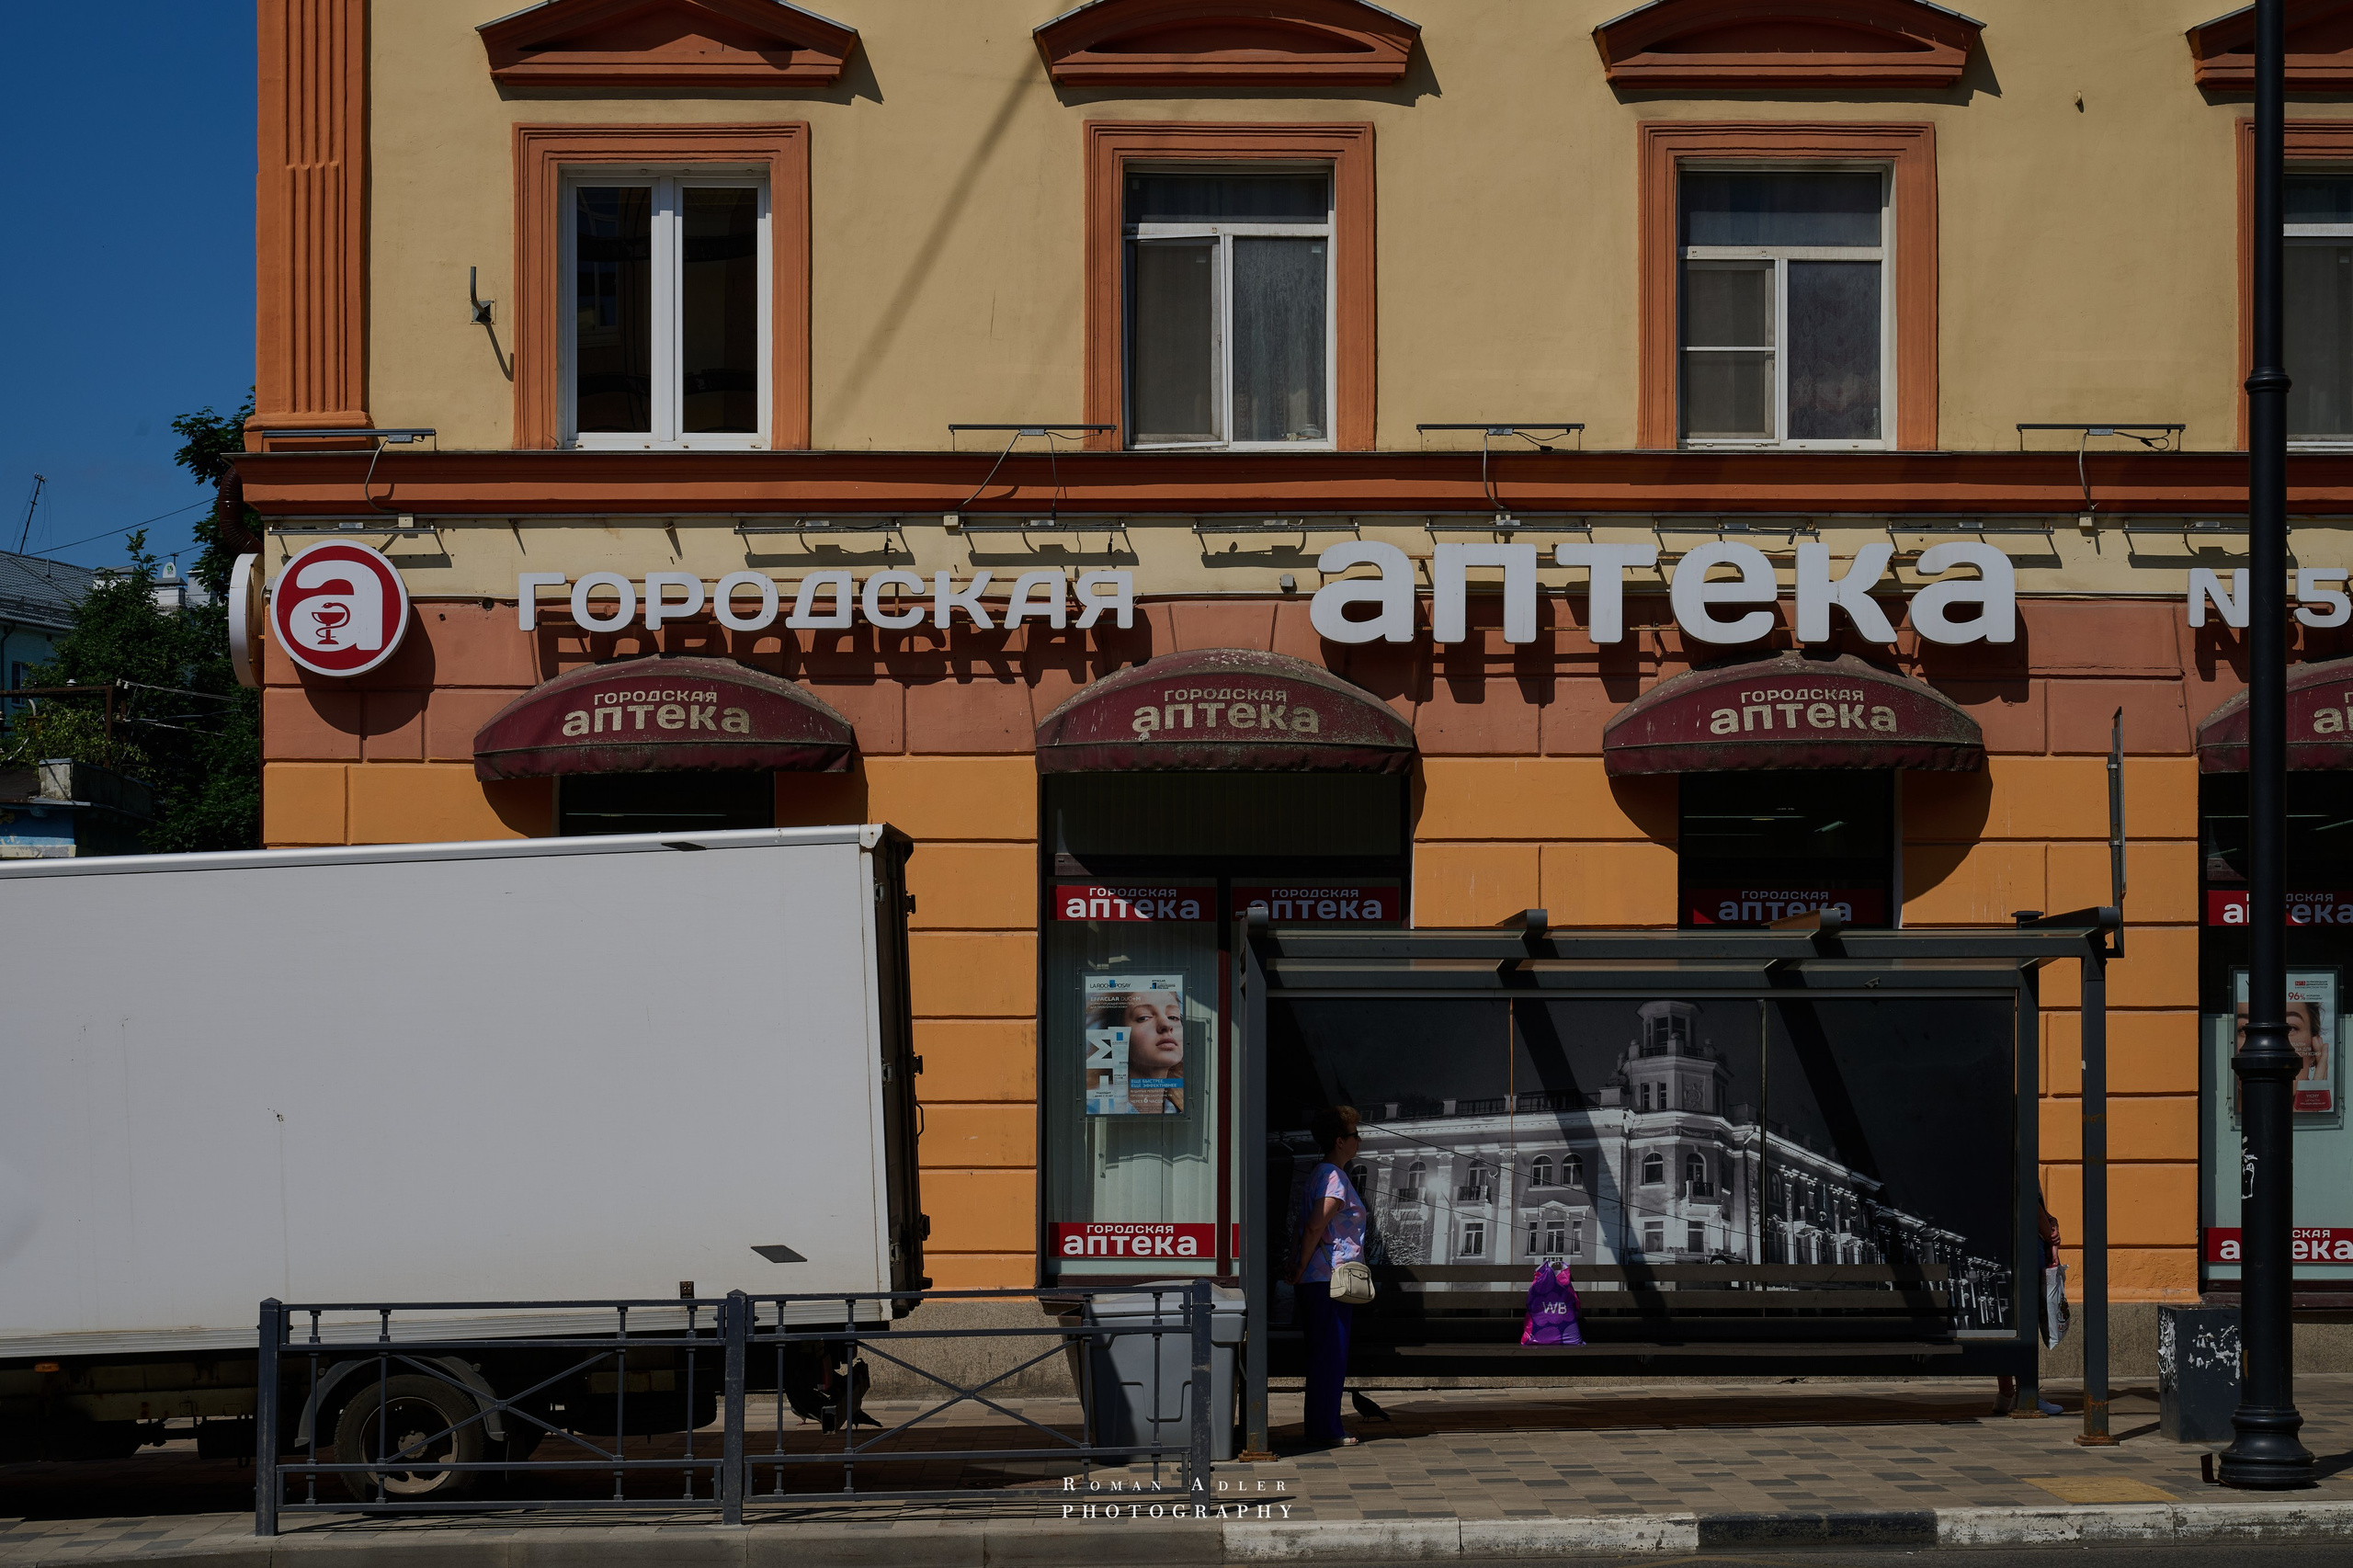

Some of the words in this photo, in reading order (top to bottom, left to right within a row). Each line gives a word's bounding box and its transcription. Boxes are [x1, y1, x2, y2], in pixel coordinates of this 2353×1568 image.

[517, 569, 1135, 632] ГОРОДСКАЯ
[1309, 540, 2017, 646] аптека
[594, 689, 718, 706] ГОРОДСКАЯ
[1164, 687, 1288, 702] ГОРОДСКАЯ
[1740, 687, 1865, 704] ГОРОДСКАЯ
[562, 702, 751, 736] аптека
[1131, 701, 1320, 733] аптека
[1709, 699, 1898, 733] аптека
[1089, 887, 1177, 898] ГОРОДСКАЯ
[1271, 889, 1359, 898] ГОРОДСКАЯ
[1741, 891, 1829, 900] ГОРОДСКАЯ
[1065, 897, 1200, 920] аптека
[2222, 903, 2353, 924] аека
[1086, 1224, 1175, 1233] ГОРОДСКАЯ
[1063, 1234, 1198, 1256] аптека
[2220, 1239, 2353, 1260] аека
[1542, 1301, 1567, 1315] WB
